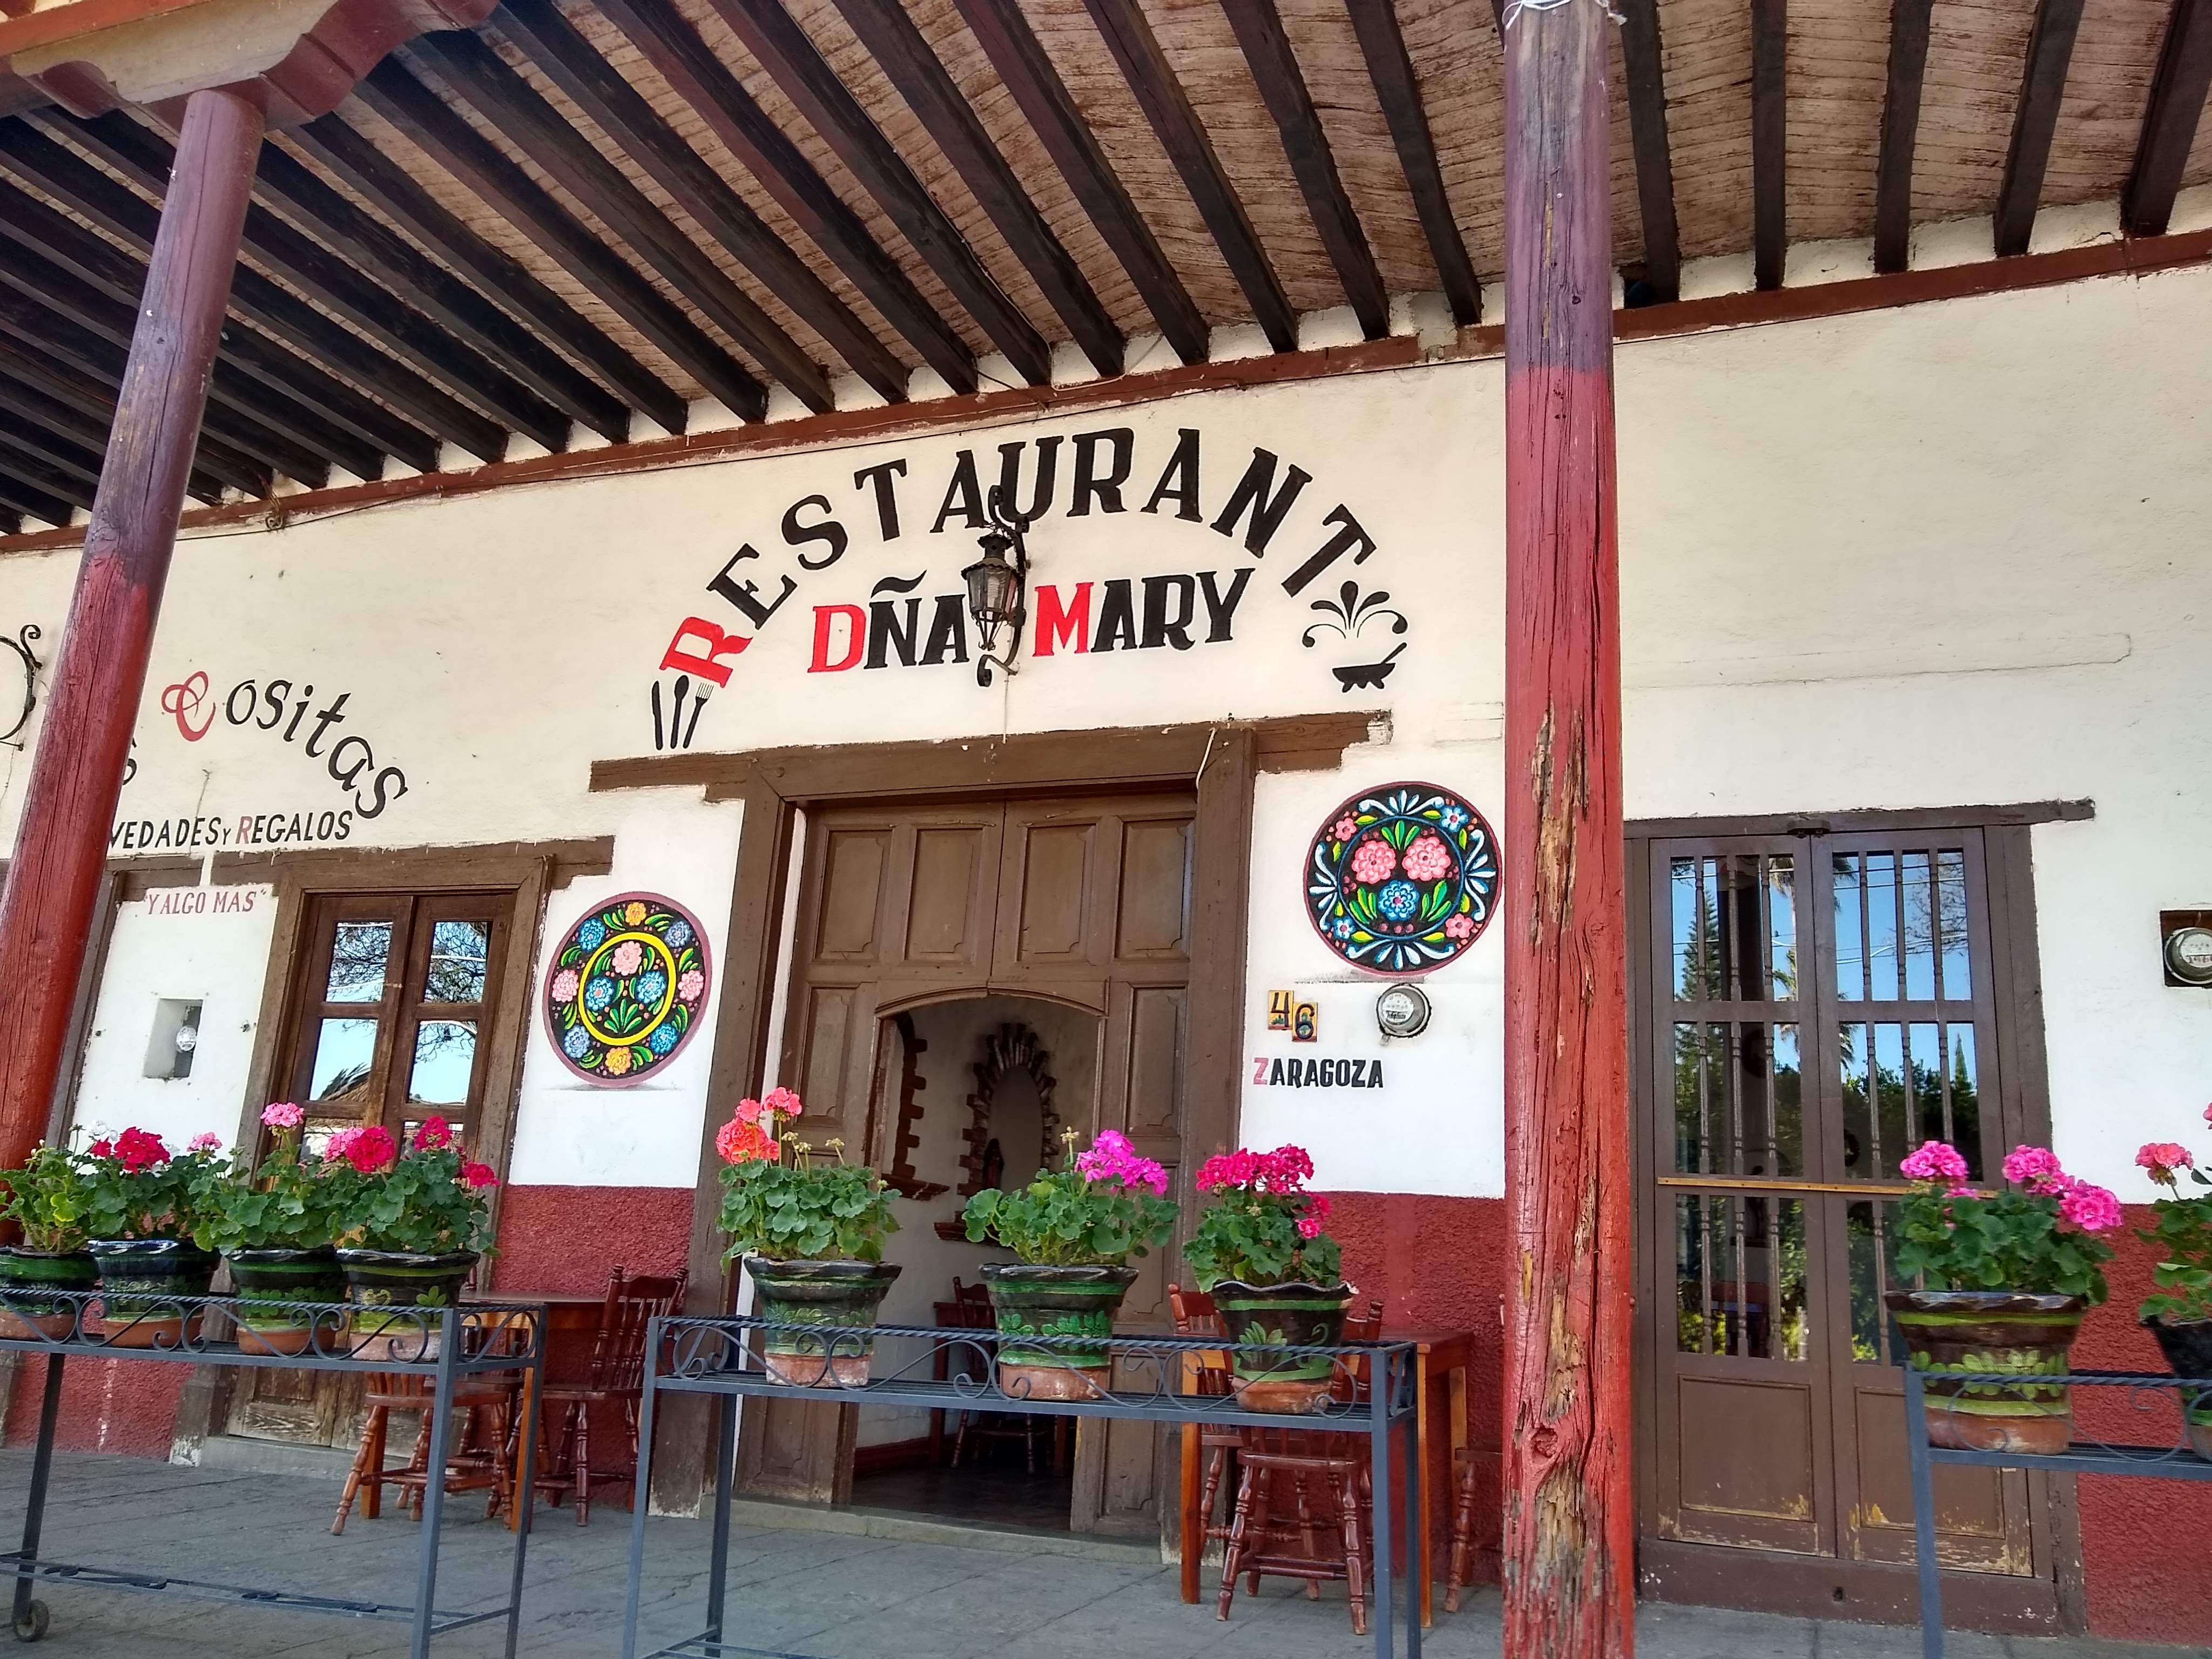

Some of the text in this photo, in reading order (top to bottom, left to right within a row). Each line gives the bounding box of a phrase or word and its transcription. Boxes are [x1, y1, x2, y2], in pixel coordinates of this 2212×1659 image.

[659, 427, 1377, 688] RESTAURANT
[807, 567, 1256, 673] DÑA MARY
[161, 671, 408, 819] Cositas
[110, 816, 221, 848] VEDADES
[235, 810, 353, 845] REGALOS
[160, 892, 206, 914] ALGO
[1271, 992, 1316, 1040] 46
[1253, 1057, 1384, 1089] ZARAGOZA
